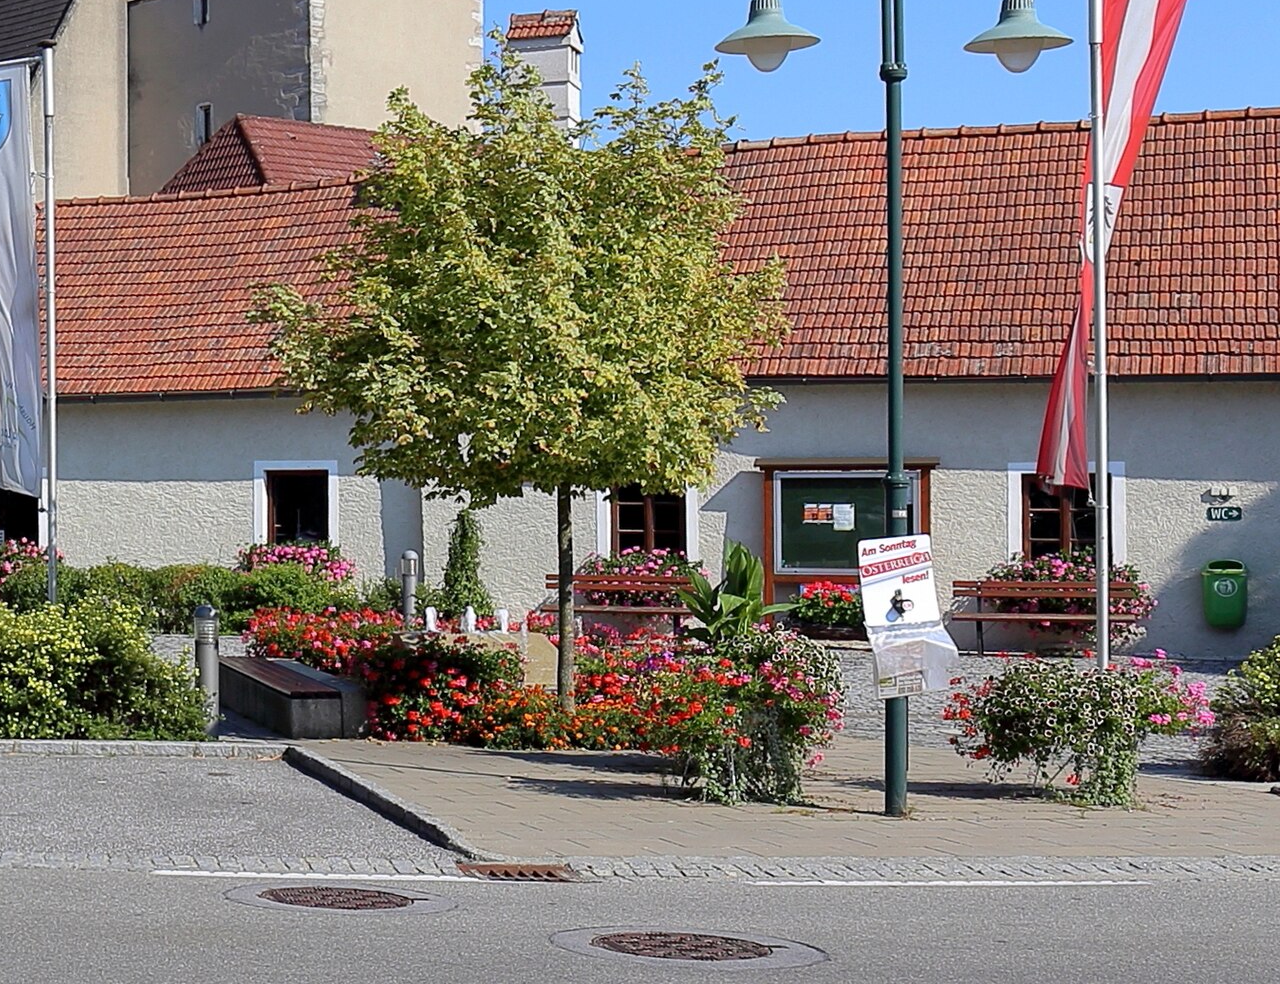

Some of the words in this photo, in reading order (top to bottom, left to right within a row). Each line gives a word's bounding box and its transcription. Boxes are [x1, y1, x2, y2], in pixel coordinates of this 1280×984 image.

[1210, 507, 1229, 520] WC
[861, 547, 877, 557] Am
[879, 539, 917, 554] Sonntag
[902, 570, 929, 584] lesen!
